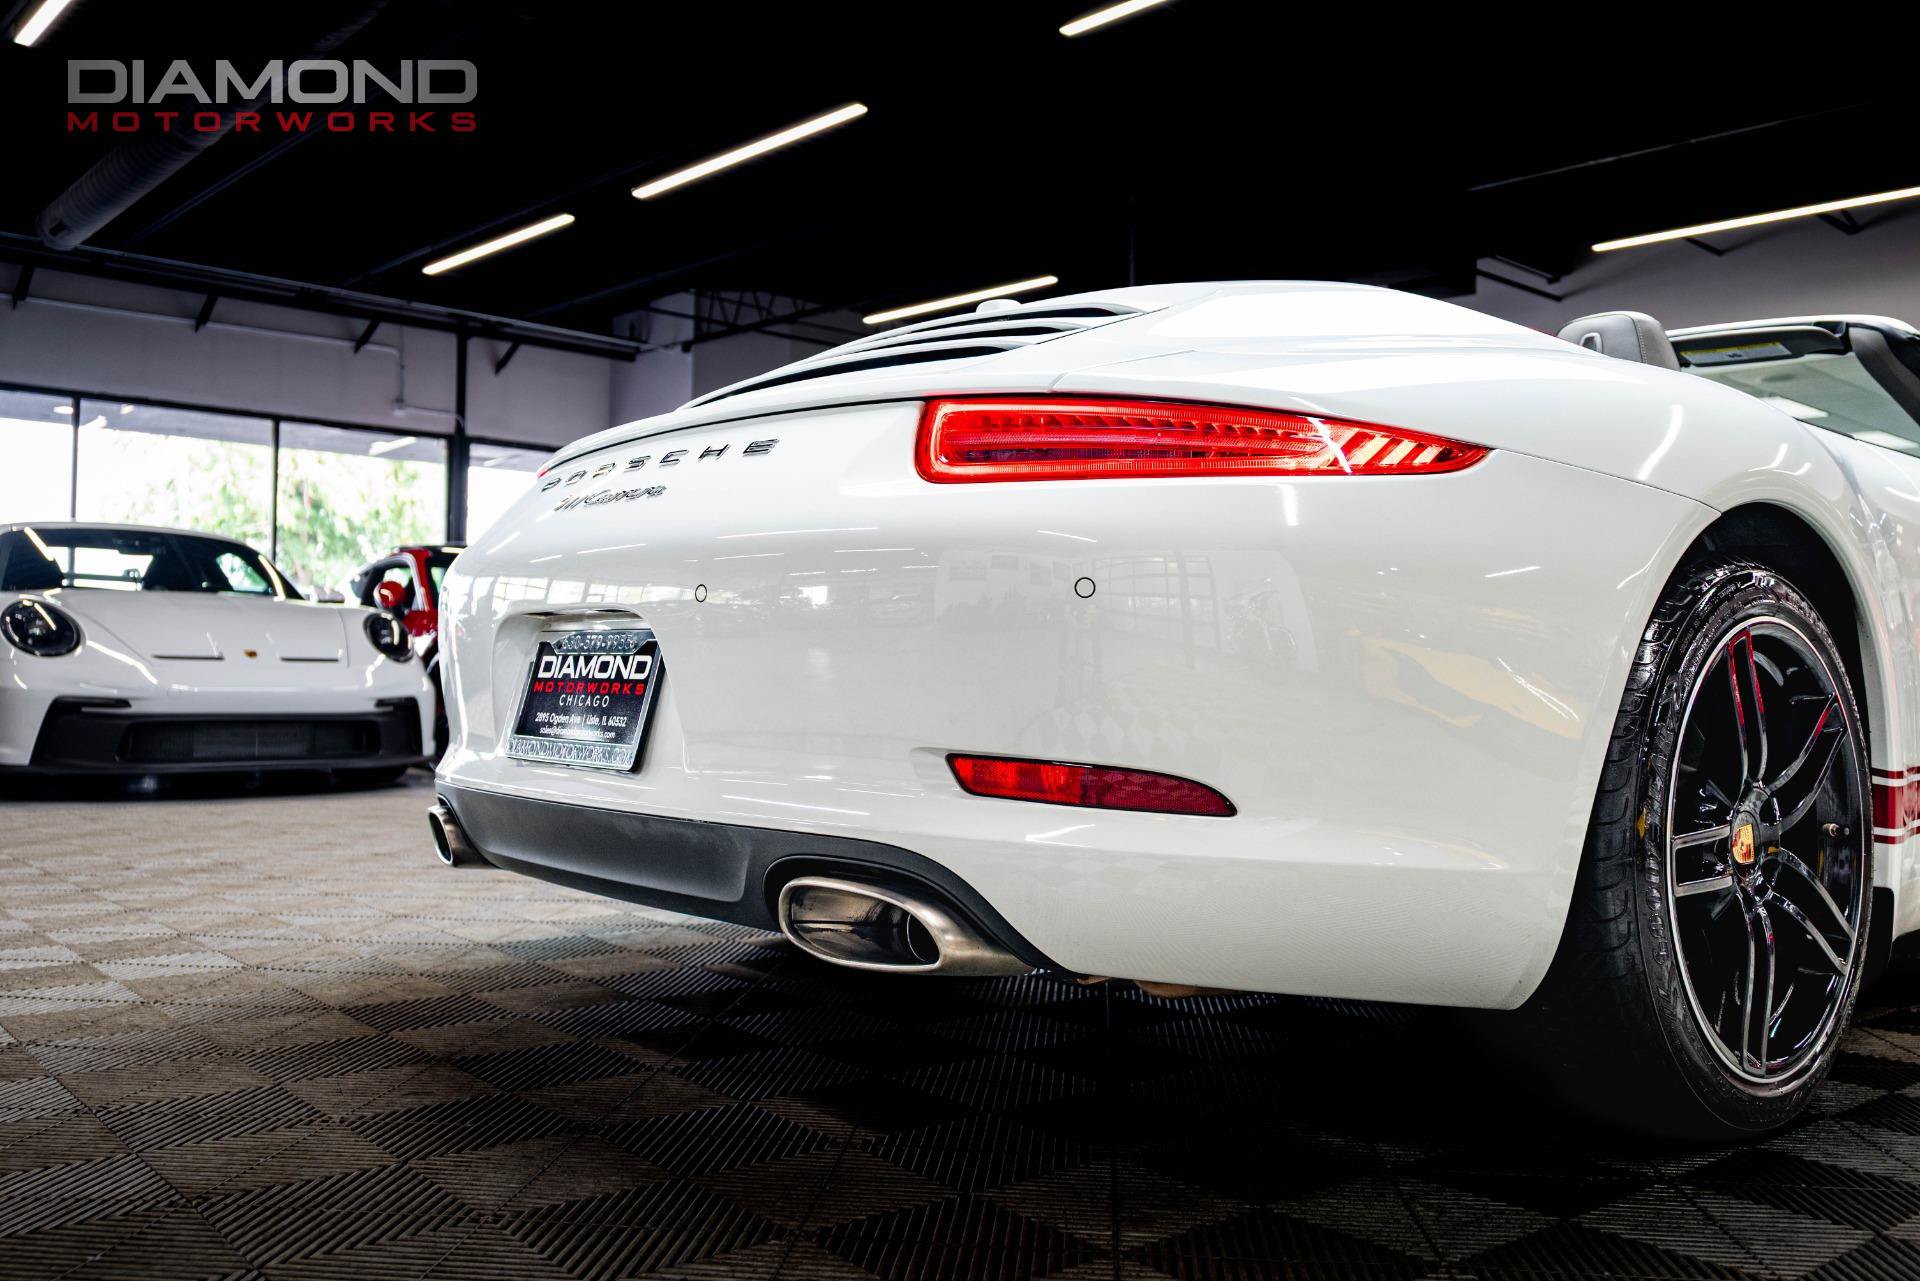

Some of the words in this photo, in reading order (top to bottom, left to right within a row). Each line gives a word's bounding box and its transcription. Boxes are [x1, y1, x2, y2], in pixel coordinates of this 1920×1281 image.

[541, 438, 780, 493] PORSCHE
[537, 655, 653, 680] DIAMOND
[533, 681, 646, 696] MOTORWORKS
[559, 695, 610, 708] CHICAGO
[550, 713, 570, 725] Ogden
[608, 716, 627, 727] 60532
[539, 726, 615, 739] sales@diamondorworks.com
